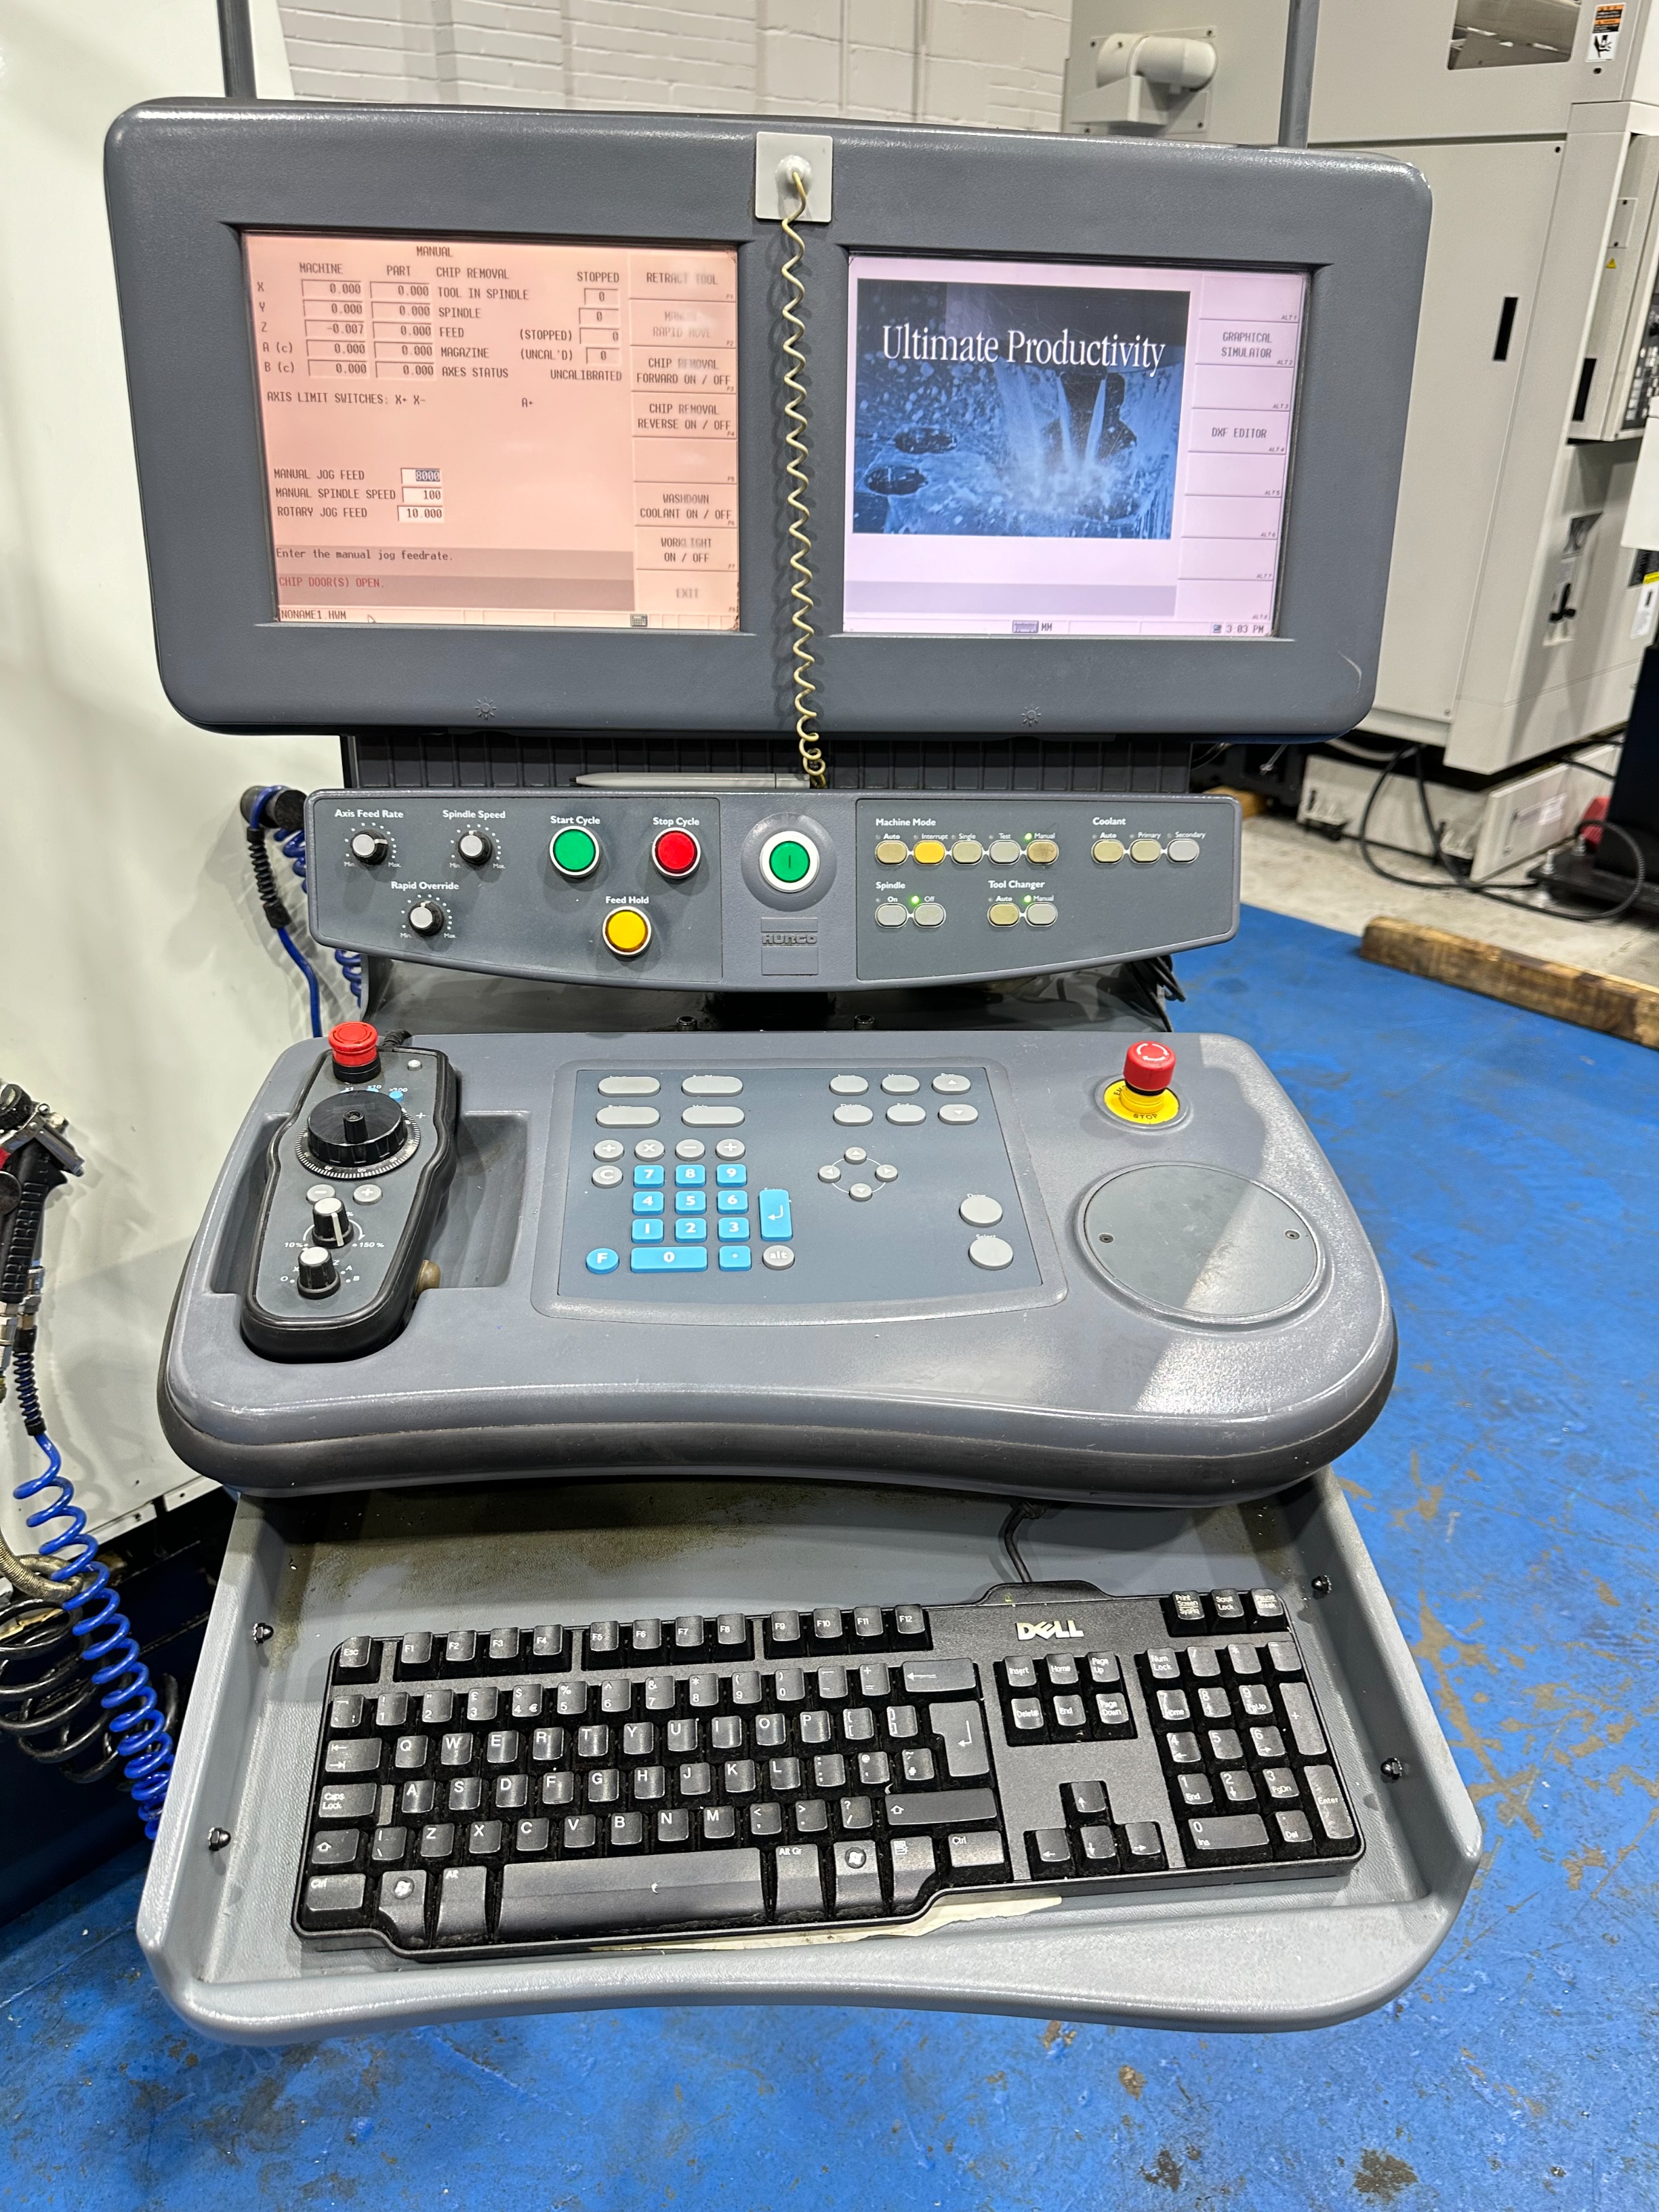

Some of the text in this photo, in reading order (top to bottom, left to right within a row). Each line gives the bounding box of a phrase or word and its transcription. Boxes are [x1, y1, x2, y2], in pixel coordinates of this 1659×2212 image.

[416, 246, 453, 258] MANUAL
[300, 263, 411, 276] MACHINE PART
[436, 267, 510, 279] CHIP REMOVAL
[577, 272, 619, 283] STOPPED
[647, 272, 718, 285] RETRACT TOOL
[257, 282, 429, 296] X 0.000 0.000
[438, 287, 529, 300] TOOL IN SPINDLE
[598, 292, 605, 302] 0
[259, 302, 430, 316] Y 0.000 0.000
[438, 308, 482, 319] SPINDLE
[596, 312, 602, 322] 0
[262, 323, 431, 336] Z -0.007 0.000
[440, 327, 464, 337] FEED
[653, 327, 683, 337] RAPID
[520, 330, 619, 342] (STOPPED) 0
[1223, 331, 1273, 343] GRAPHICAL
[263, 343, 269, 352] A
[334, 344, 365, 354] 0.000
[401, 345, 432, 356] 0.000
[441, 347, 489, 358] MAGAZINE
[882, 323, 1166, 377] Ultimate Productivity
[1221, 347, 1271, 359] SIMULATOR
[520, 350, 607, 361] (UNCAL'D) 0
[264, 362, 271, 372] B
[335, 363, 367, 373] 0.000
[403, 365, 434, 375] 0.000
[648, 359, 719, 370] CHIP REMOVAL
[442, 367, 509, 378] AXES STATUS
[550, 369, 622, 382] UNCALIBRATED
[636, 373, 678, 384] FORWARD
[684, 374, 696, 384] ON
[713, 375, 731, 385] OFF
[267, 392, 426, 405] AXIS LIMIT SWITCHES: X+ X-
[522, 398, 533, 407] A+
[649, 404, 719, 415] CHIP REMOVAL
[638, 419, 679, 429] REVERSE
[684, 419, 697, 430] ON
[714, 420, 731, 430] OFF
[1212, 428, 1267, 438] DXF EDITOR
[274, 469, 440, 481] MANUAL JOG FEED 8000
[275, 487, 441, 499] MANUAL SPINDLE SPEED 100
[663, 494, 709, 504] WASHDOWN
[277, 506, 442, 518] ROTARY JOG FEED 10.000
[640, 508, 680, 518] COOLANT
[687, 510, 698, 518] ON
[715, 510, 732, 519] OFF
[661, 537, 712, 548] WORKLIGHT
[276, 548, 453, 560] Enter the manual jog feedrate.
[664, 553, 676, 562] ON
[693, 553, 709, 562] OFF
[279, 577, 385, 588] CHIP DOOR(S) OPEN.
[676, 588, 699, 598] EXIT
[281, 610, 346, 619] NONAME1.HWM
[1041, 622, 1053, 632] MM
[1226, 624, 1264, 634] 3:03 PM
[335, 810, 403, 818] Axis Feed Rate
[443, 810, 506, 820] Spindle Speed
[550, 816, 600, 825] Start Cycle
[653, 817, 700, 827] Stop Cycle
[876, 818, 911, 826] Machine
[1092, 817, 1126, 825] Coolant
[391, 882, 459, 891] Rapid Override
[876, 882, 905, 890] Spindle
[1008, 880, 1045, 890] Changer
[605, 896, 649, 904] Feed Hold
[762, 934, 817, 945] HURCO
[600, 1170, 614, 1179] C
[644, 1170, 653, 1179] 7
[685, 1169, 695, 1179] 8
[726, 1168, 737, 1178] 9
[597, 1252, 608, 1264] F
[663, 1252, 674, 1263] 0
[769, 1250, 787, 1259] alt
[899, 1615, 913, 1623] F12
[1016, 1620, 1084, 1641] DELL
[344, 1648, 359, 1656] Esc
[1008, 1666, 1029, 1675] Insert
[1051, 1664, 1071, 1673] Home
[1059, 1706, 1073, 1715] End
[1317, 1796, 1338, 1804] Enter
[311, 1878, 327, 1888] Ctrl
